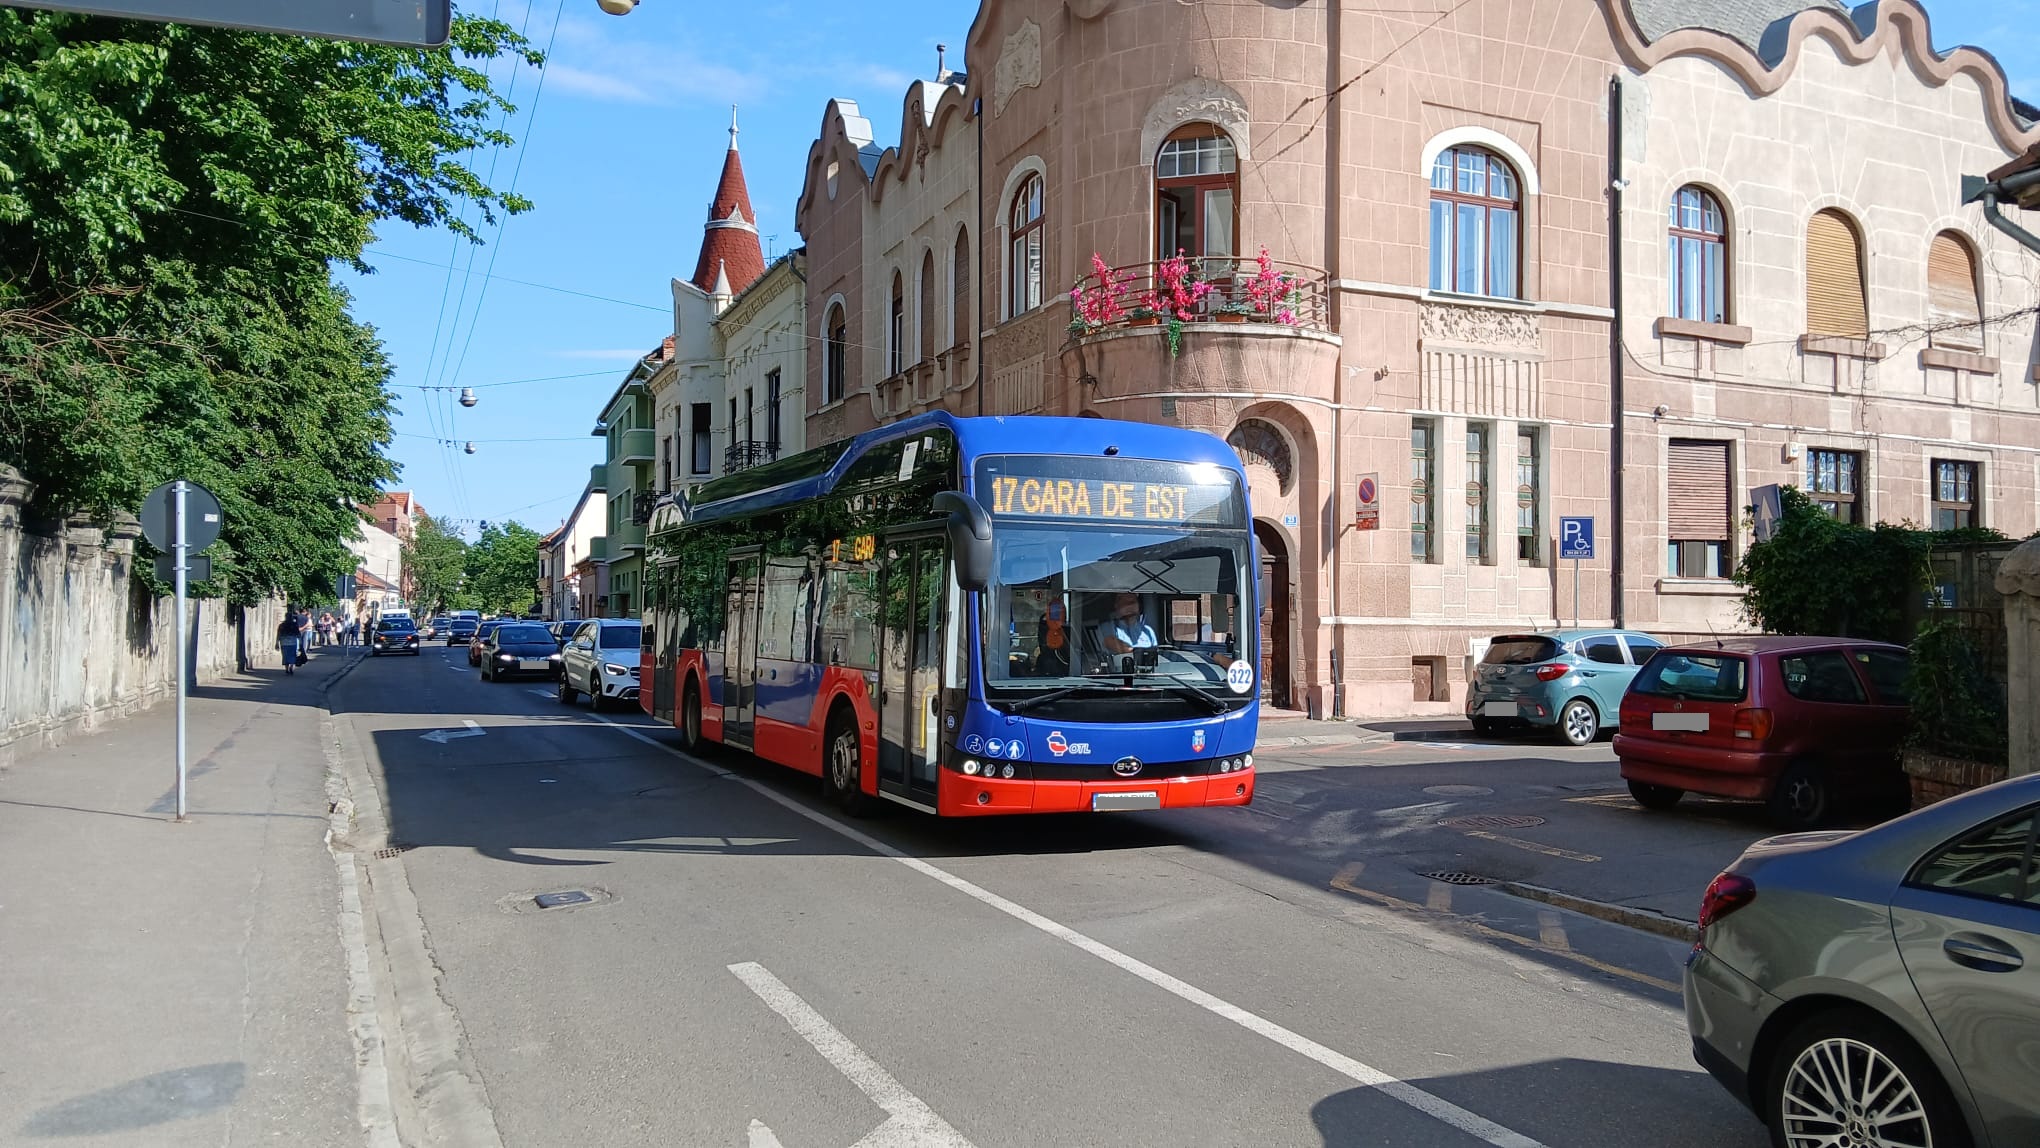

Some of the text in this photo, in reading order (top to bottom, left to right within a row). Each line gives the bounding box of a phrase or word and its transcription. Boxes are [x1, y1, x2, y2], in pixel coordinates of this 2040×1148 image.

[992, 477, 1188, 520] 17 GARA DE EST
[1563, 520, 1581, 542] P
[832, 539, 841, 562] 17
[1229, 668, 1251, 684] 322
[1068, 742, 1092, 755] OTL
